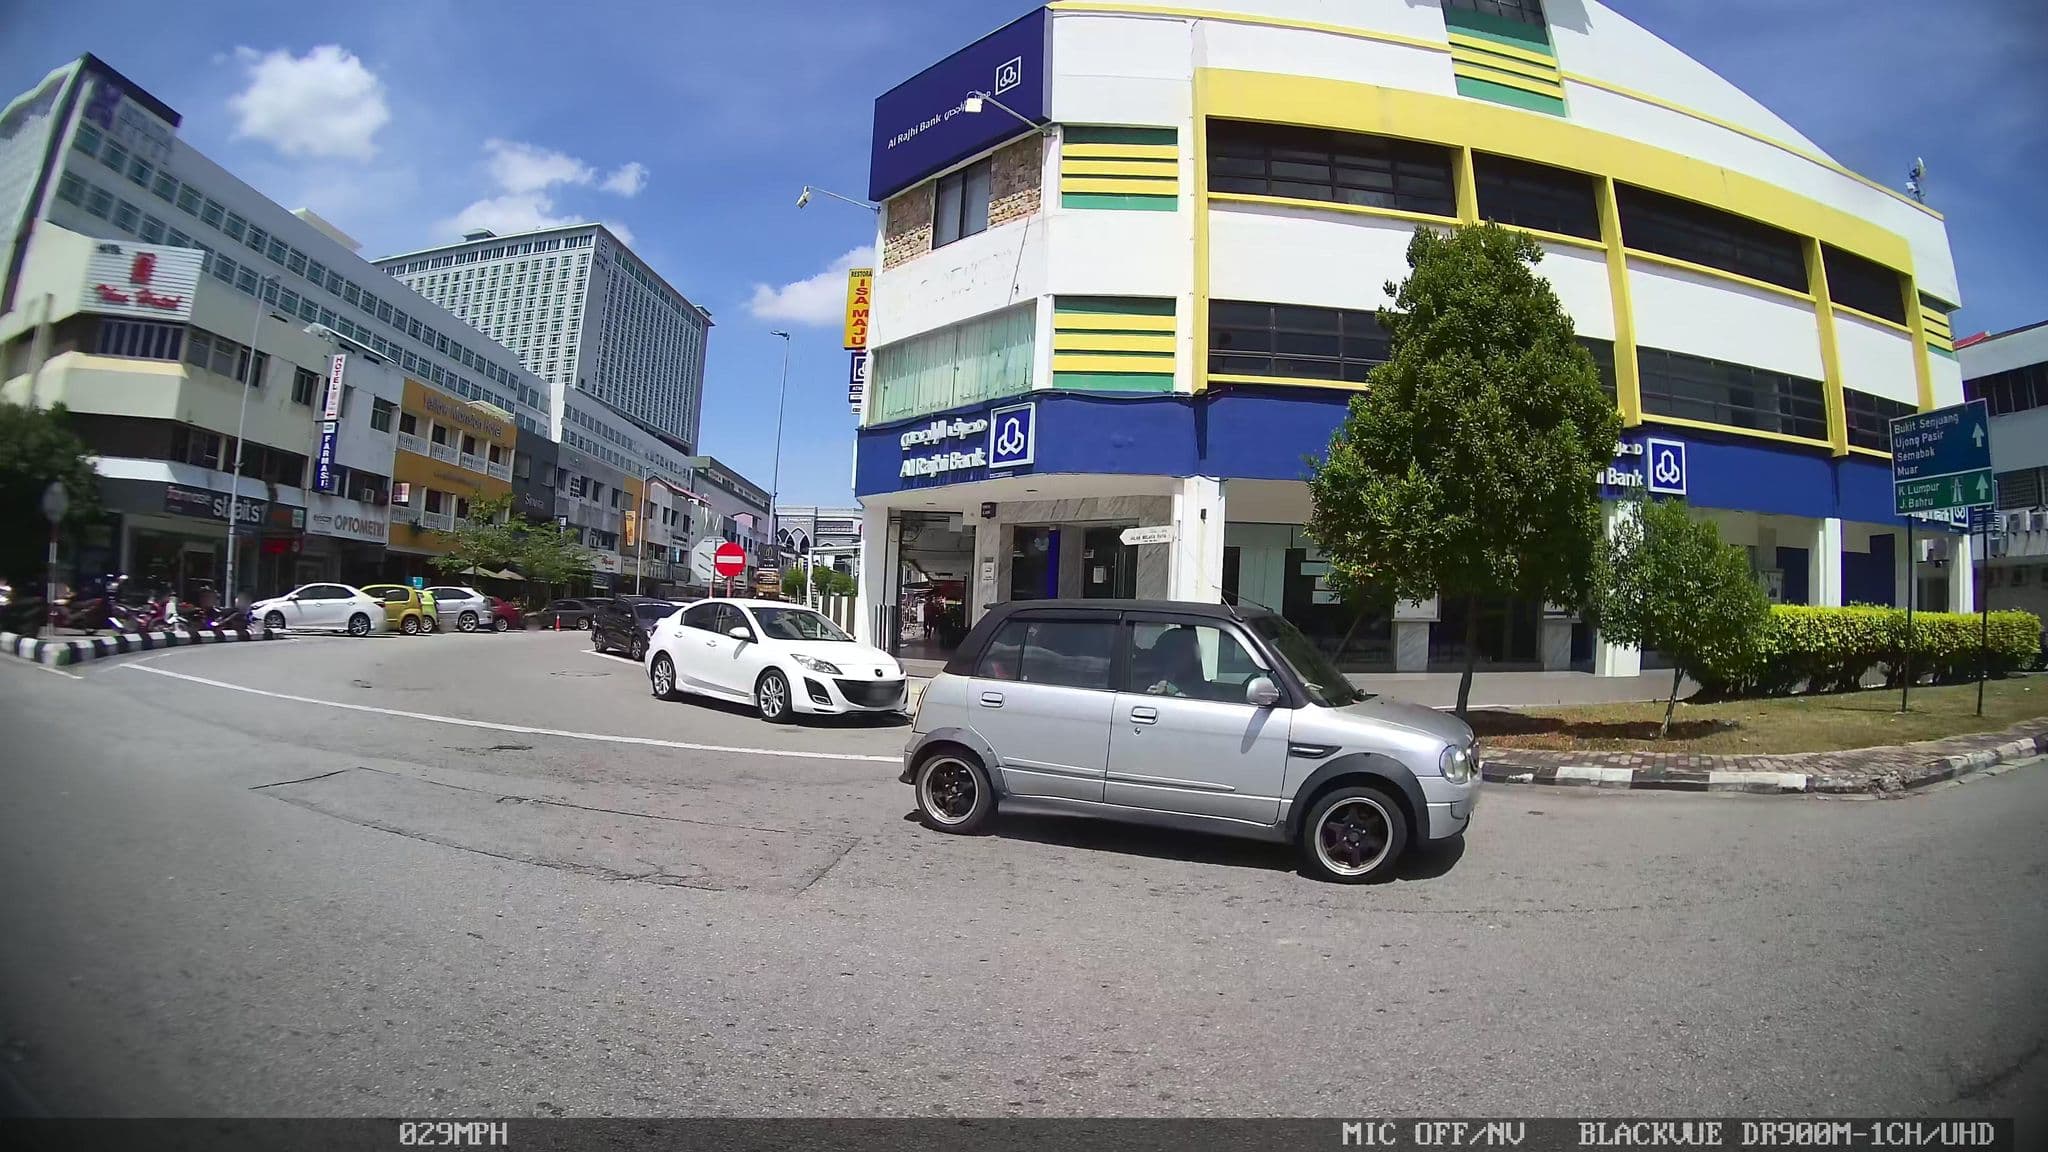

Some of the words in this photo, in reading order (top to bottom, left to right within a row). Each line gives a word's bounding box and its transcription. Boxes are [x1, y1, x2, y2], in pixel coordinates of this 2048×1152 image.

[887, 136, 897, 150] Al
[897, 124, 919, 144] Rajhi
[919, 113, 942, 133] Bank
[851, 270, 873, 278] RESTORA
[854, 278, 869, 305] ISA
[851, 309, 869, 345] MAJU
[332, 355, 344, 391] HOTEL
[1894, 422, 1916, 435] Bukit
[1919, 413, 1960, 429] Senjuang
[1895, 436, 1920, 449] Ujong
[1921, 430, 1944, 443] Pasir
[320, 434, 331, 487] FARMASI
[899, 458, 916, 478] Al
[915, 453, 950, 478] Rajhi
[949, 447, 987, 470] Bank
[1897, 446, 1936, 462] Semabok
[1607, 467, 1644, 488] Bank
[1897, 465, 1919, 477] Muar
[1907, 482, 1940, 495] Lumpur
[212, 495, 261, 523] staits
[1908, 497, 1934, 509] Bahru
